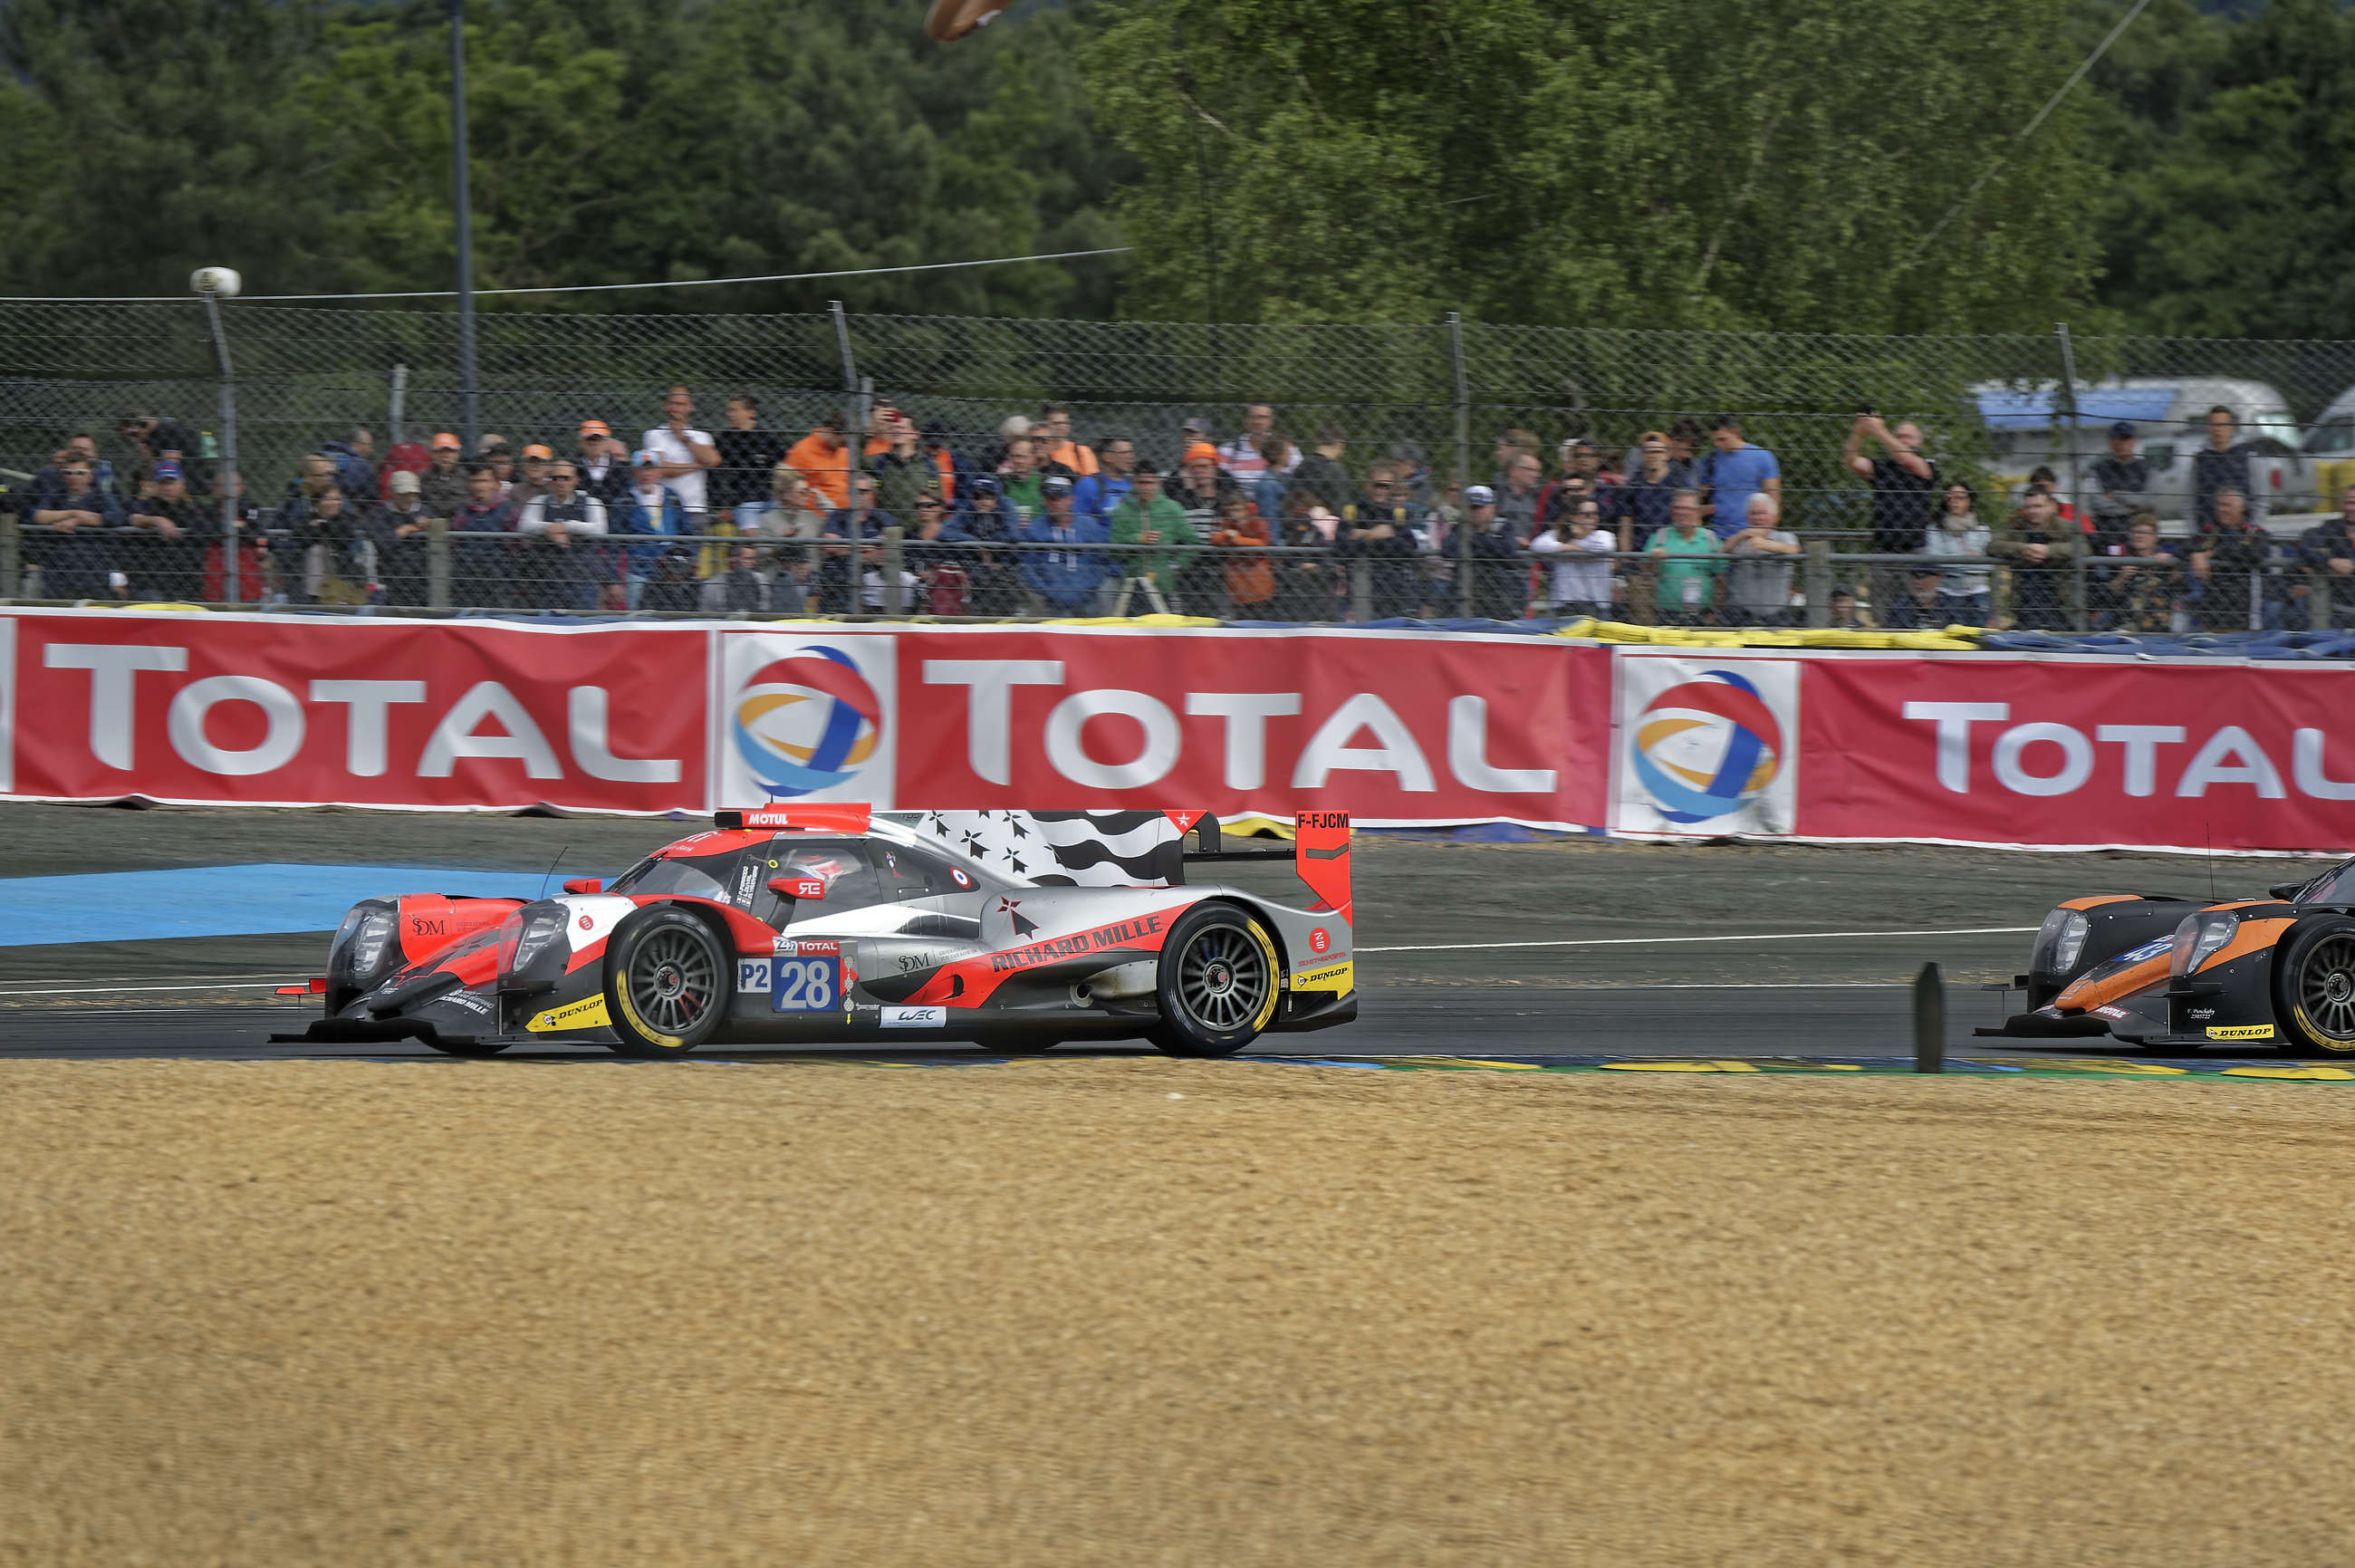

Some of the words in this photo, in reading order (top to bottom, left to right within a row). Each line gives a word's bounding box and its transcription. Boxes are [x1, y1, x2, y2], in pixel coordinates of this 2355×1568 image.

[43, 643, 681, 784] TOTAL
[923, 659, 1557, 794] TOTAL
[1902, 701, 2355, 802] TOTAL
[749, 813, 788, 824] MOTUL
[1298, 813, 1349, 828] F-FJCM
[412, 918, 445, 936] SDM
[798, 941, 838, 951] TOTAL
[991, 935, 1090, 973] RICHARD
[1093, 916, 1164, 948] MILLE
[899, 953, 930, 971] SDM
[741, 964, 768, 990] P2
[1310, 967, 1348, 982] DUNLOP
[781, 960, 831, 1009] 28
[558, 999, 603, 1019] DUNLOP
[898, 1010, 937, 1021] WEC
[2219, 1028, 2272, 1036] DUNLOP
